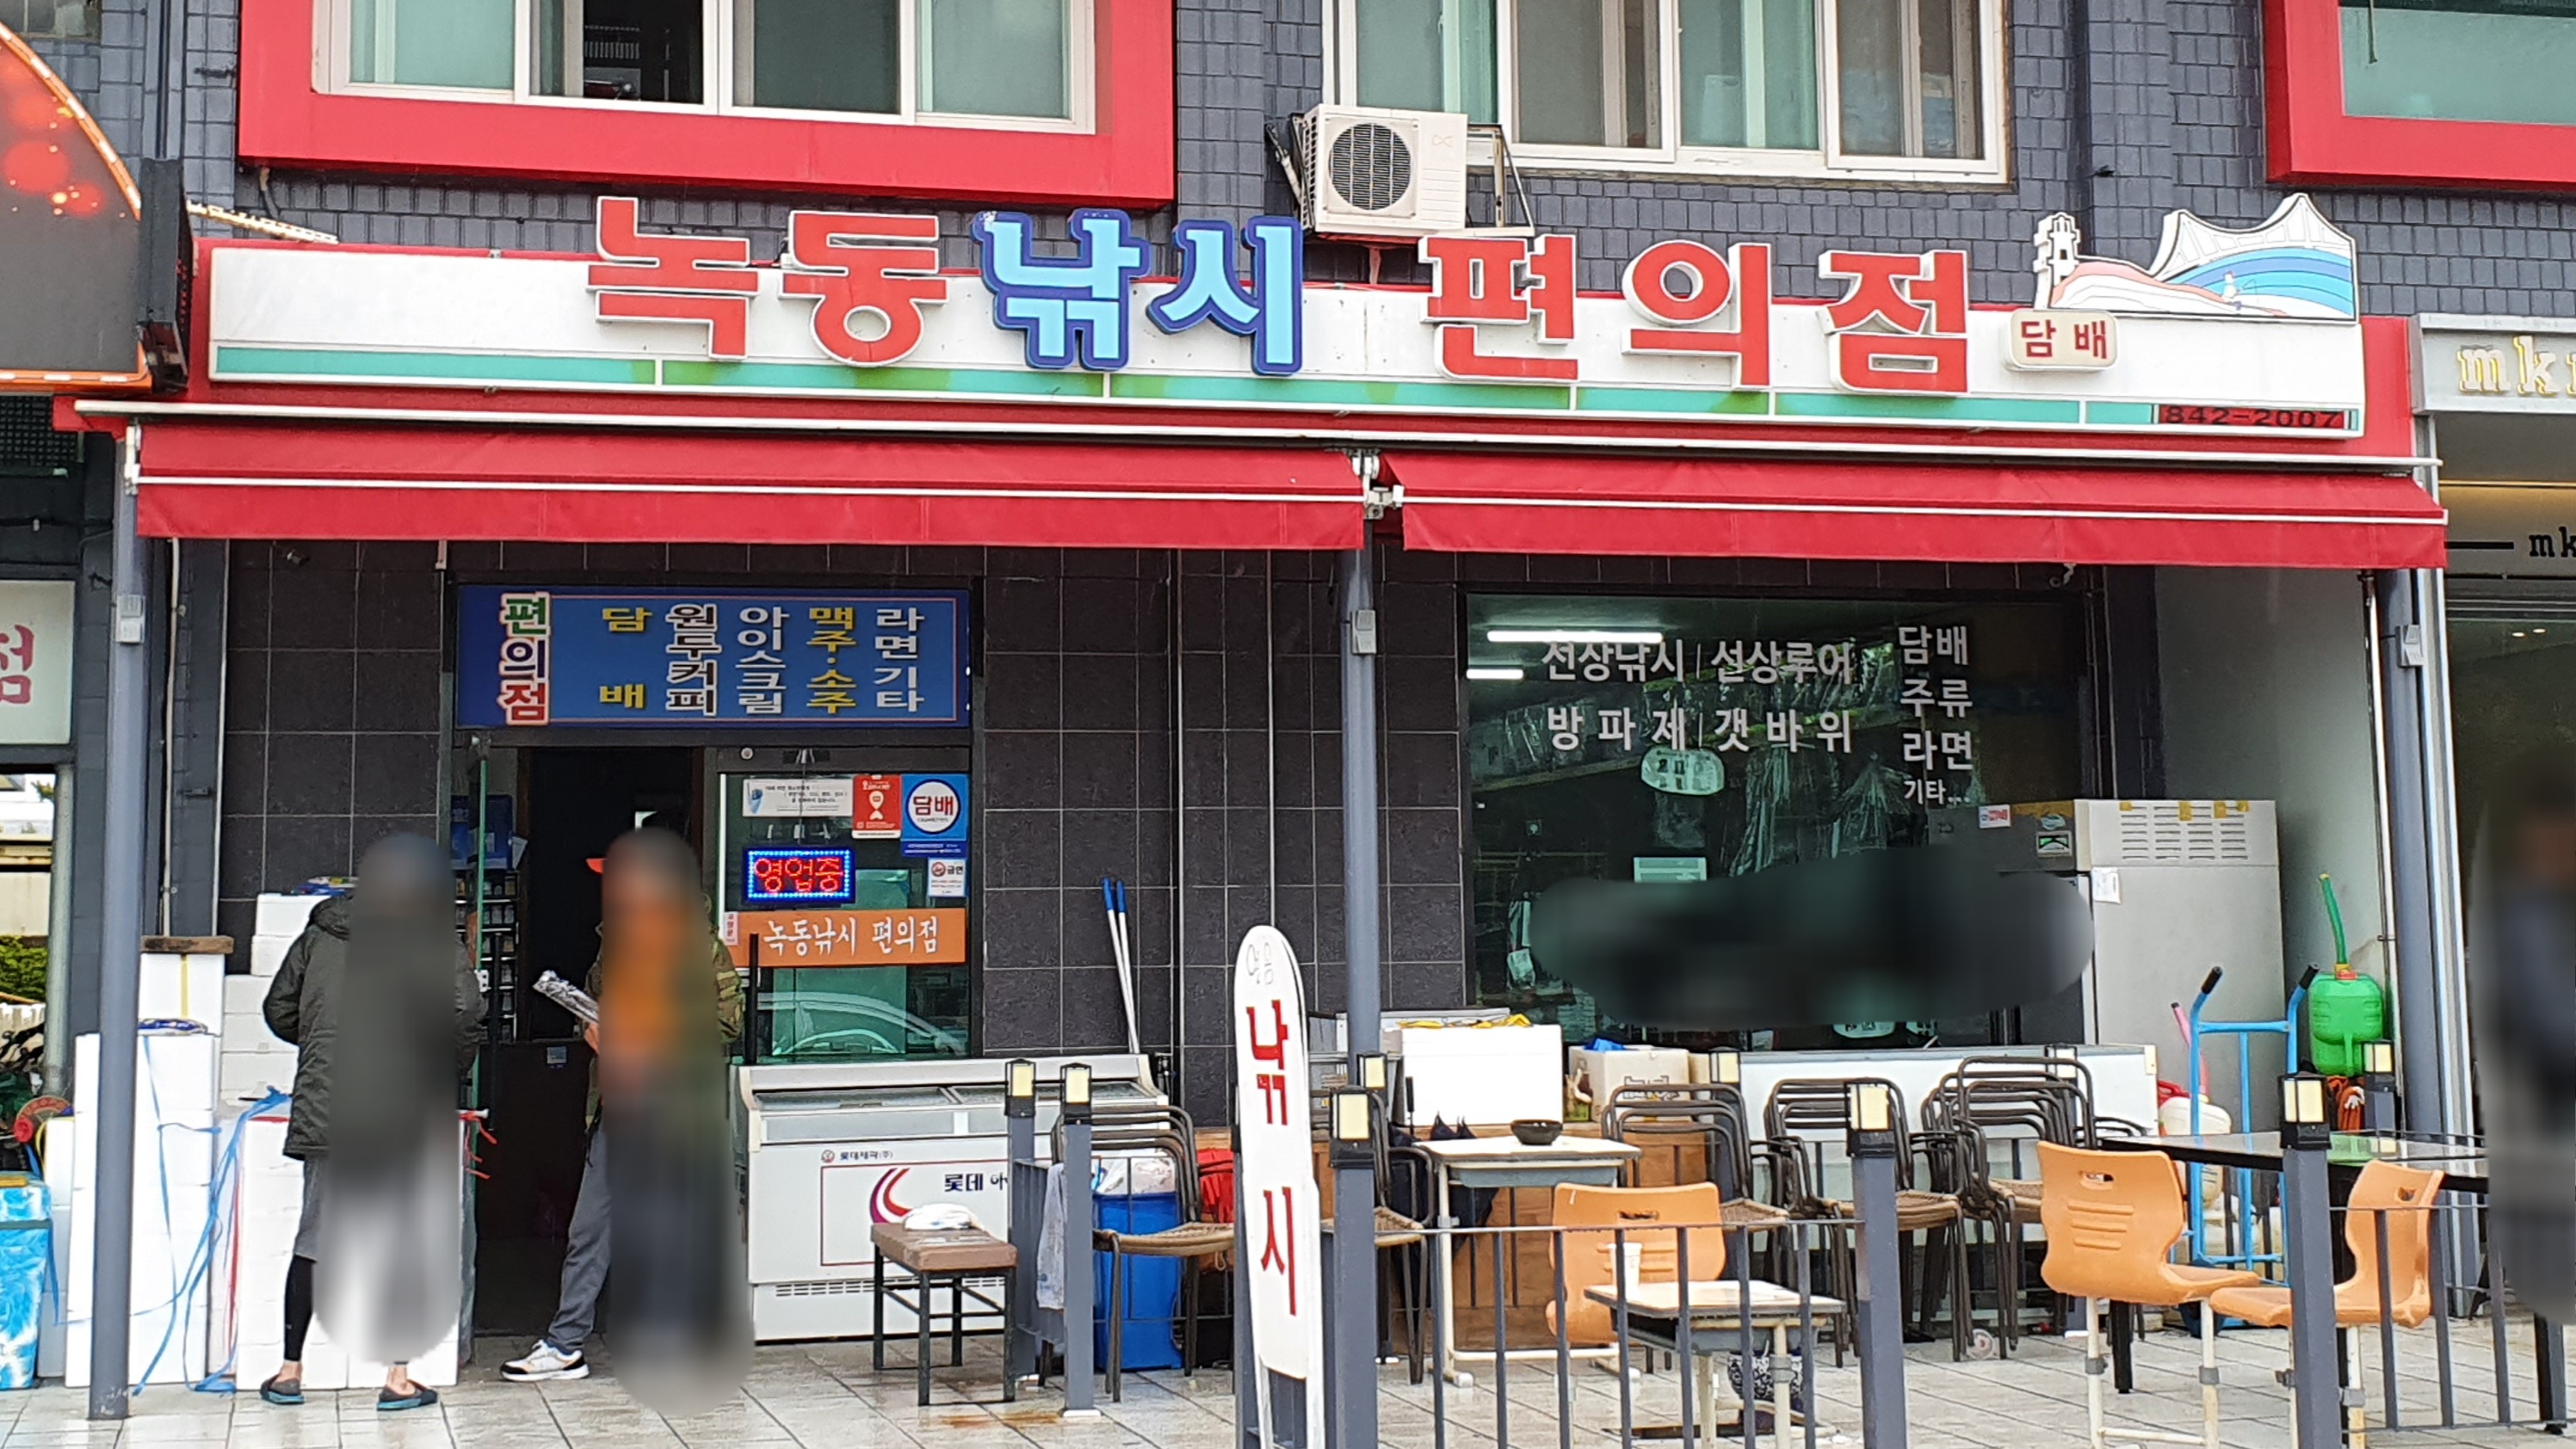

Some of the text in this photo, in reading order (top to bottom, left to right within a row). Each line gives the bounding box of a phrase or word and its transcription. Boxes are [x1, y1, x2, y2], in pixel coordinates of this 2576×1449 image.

[1419, 233, 1969, 394] 편의점
[2020, 319, 2108, 360] 담배
[2456, 335, 2576, 397] mk
[2165, 405, 2340, 429] 842-2007
[497, 591, 551, 725] 편의점
[599, 607, 653, 709] 담배
[665, 604, 723, 717] 원두커피
[735, 607, 790, 714] 아이스크림
[873, 607, 925, 712] 라면 기타
[1541, 639, 1851, 685] 선상낚시 선상루어
[1899, 625, 1969, 666] 담배
[1900, 679, 1974, 718] 주류
[1903, 731, 1974, 771] 라면
[912, 795, 954, 817] 담배
[754, 857, 844, 893] 영업중
[947, 866, 964, 876] 금연
[763, 915, 938, 957] 녹동낚시 편의점
[1245, 999, 1298, 1317] 낚시
[944, 1173, 984, 1193] 롯데
